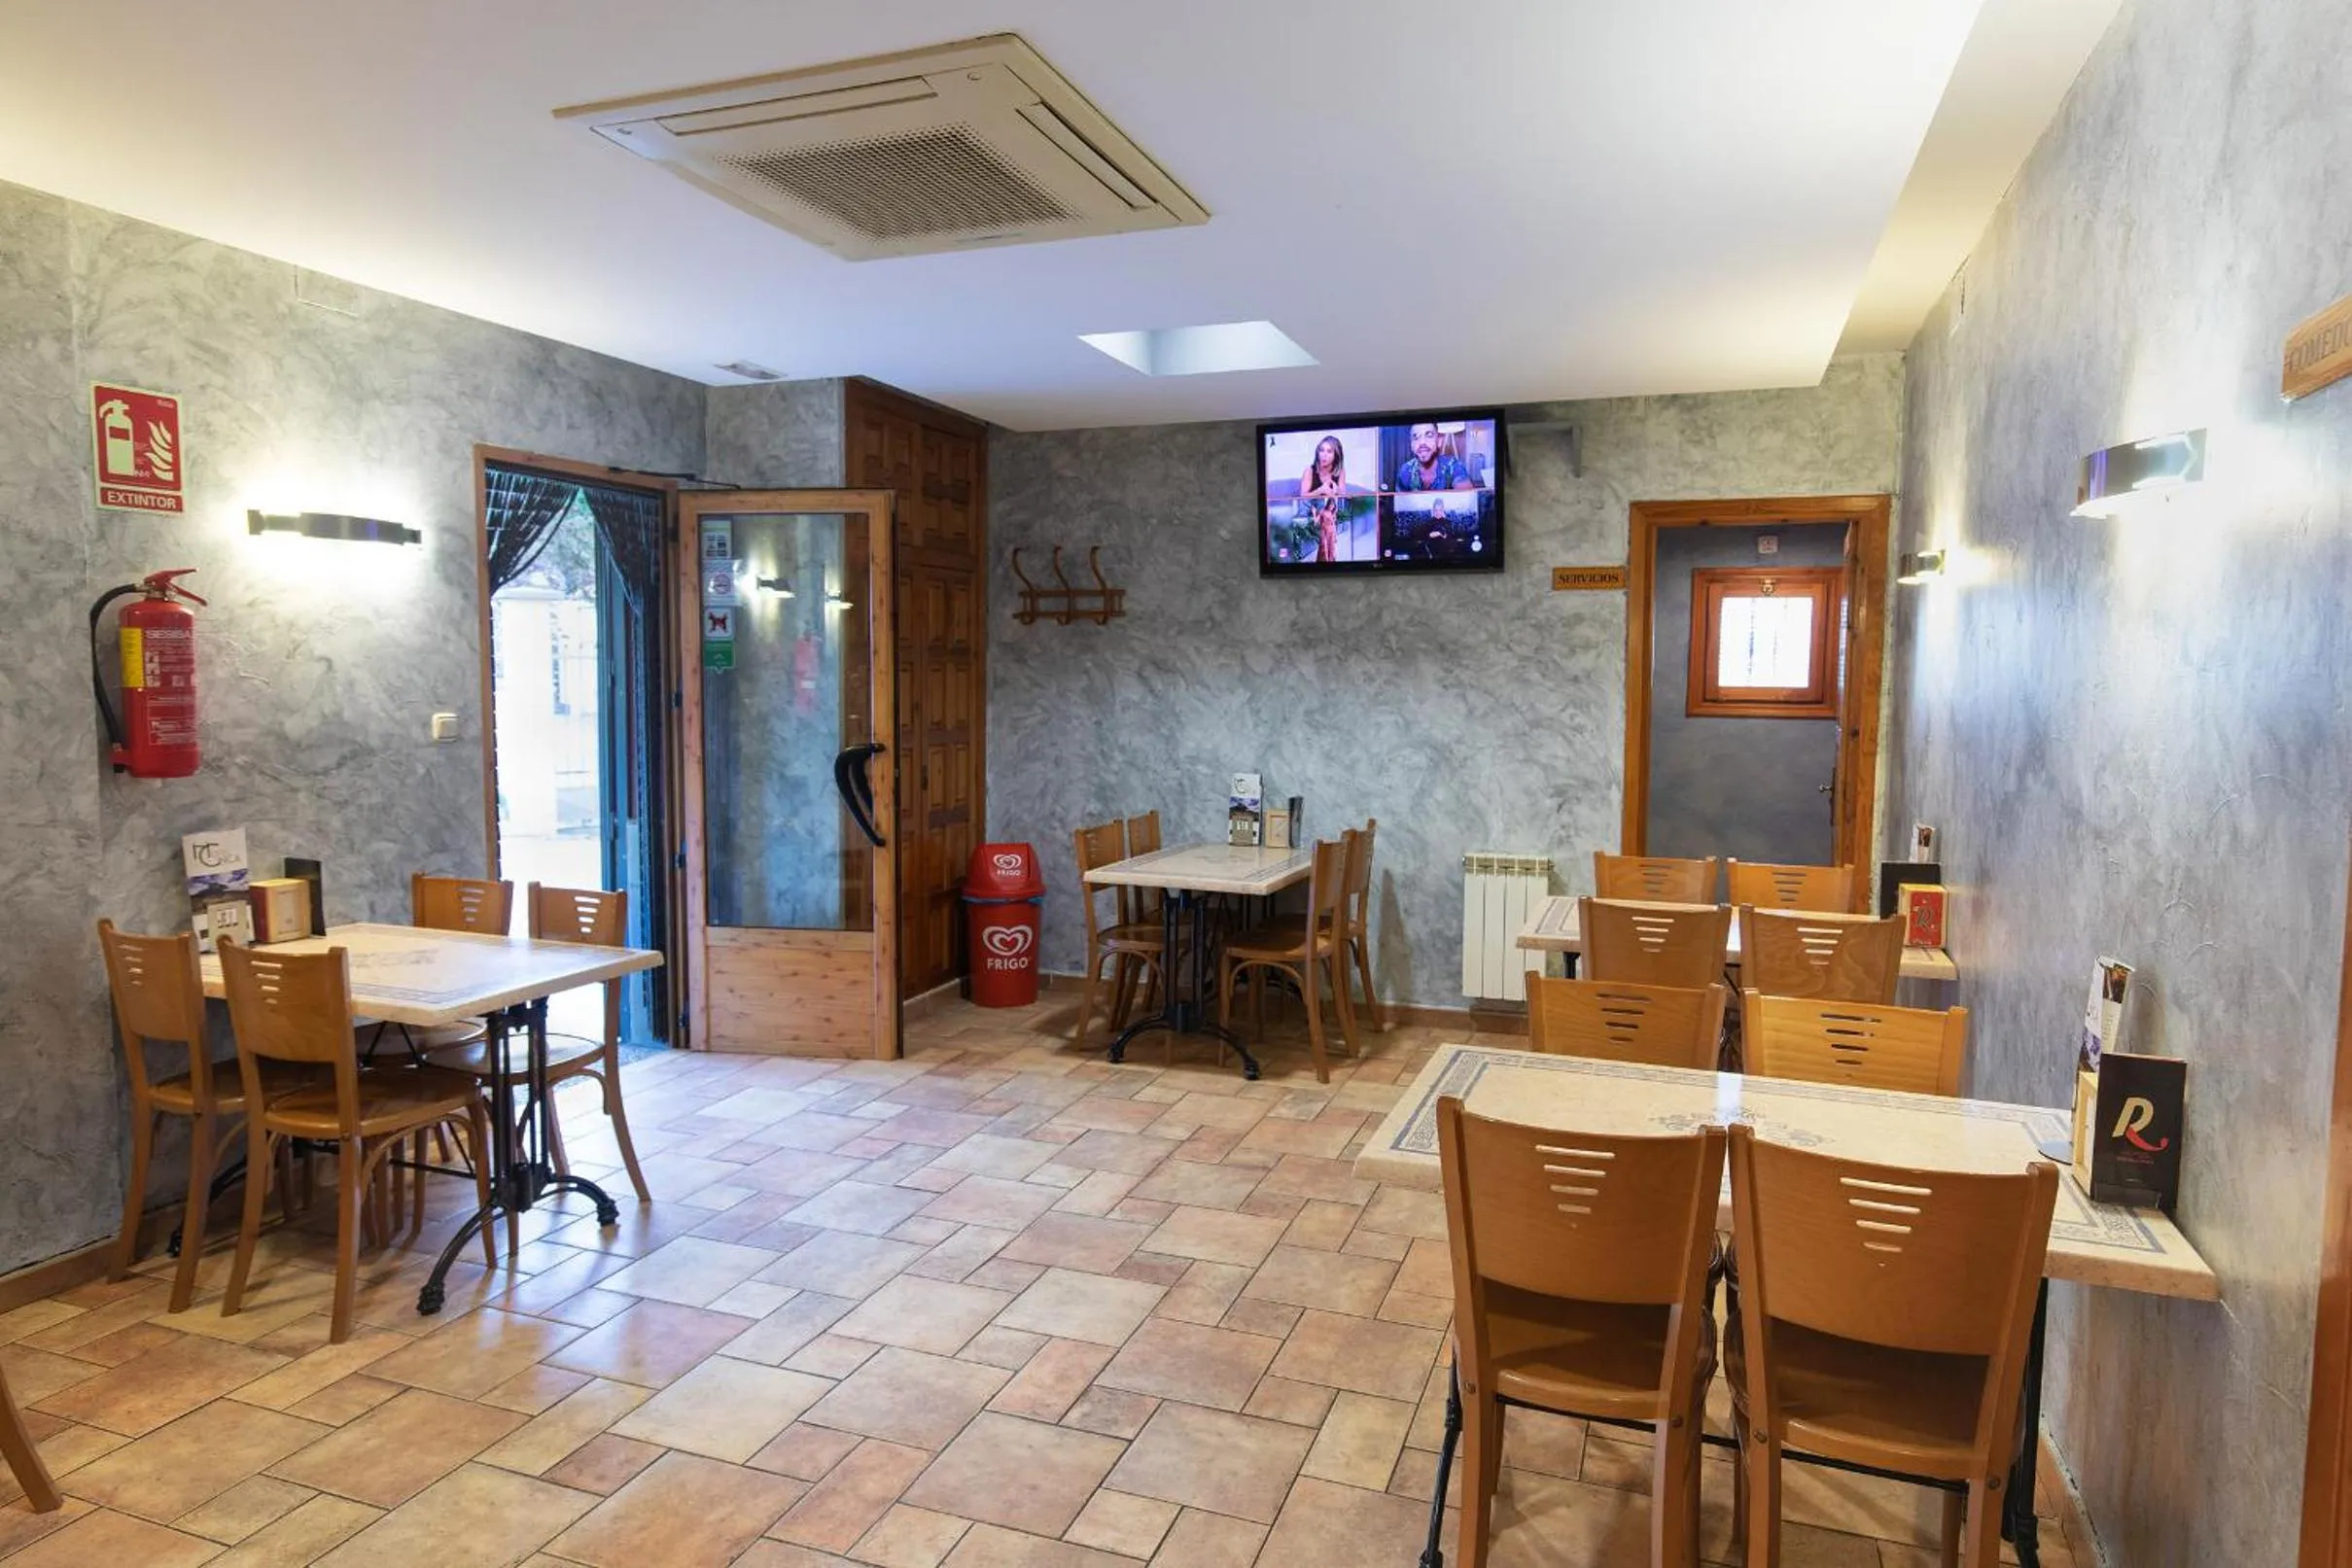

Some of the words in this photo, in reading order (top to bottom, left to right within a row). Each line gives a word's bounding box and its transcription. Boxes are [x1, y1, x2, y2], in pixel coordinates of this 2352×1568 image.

[107, 490, 176, 508] EXTINTOR
[1559, 574, 1619, 583] SERVICIOS
[987, 957, 1029, 970] FRIGO
